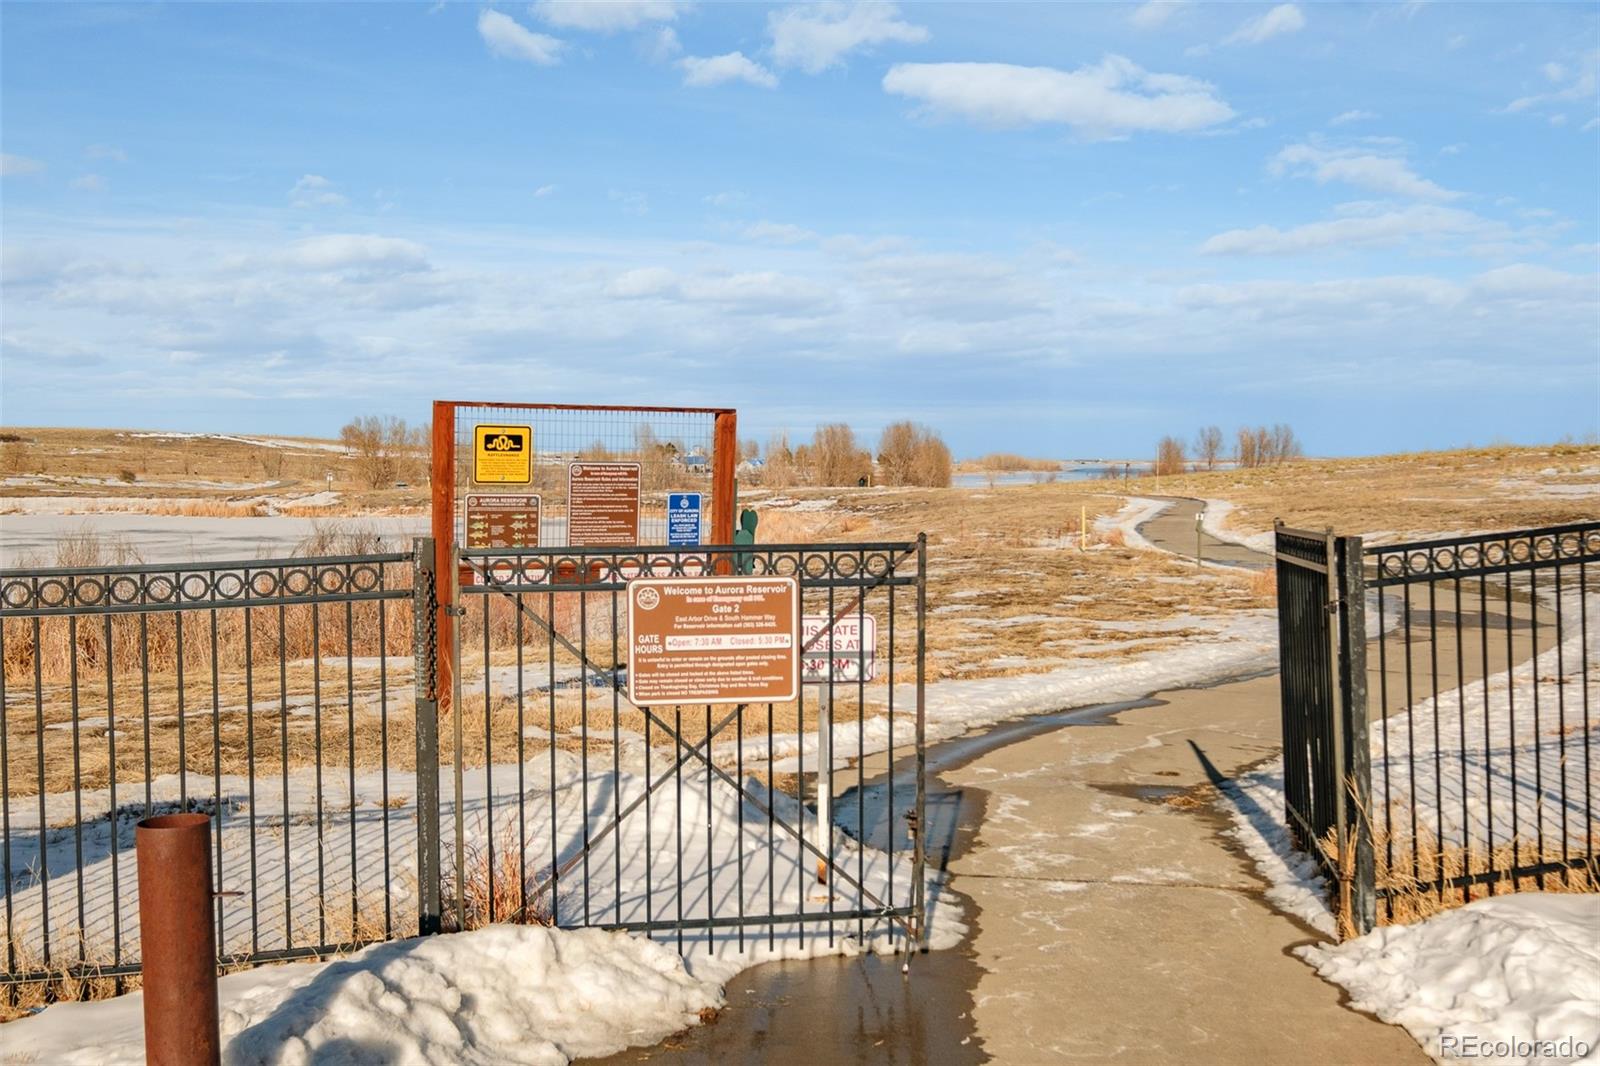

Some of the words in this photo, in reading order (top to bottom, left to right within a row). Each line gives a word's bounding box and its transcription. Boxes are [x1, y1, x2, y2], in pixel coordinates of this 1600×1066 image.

[664, 586, 702, 595] Welcome
[704, 586, 713, 594] to
[715, 586, 745, 594] Aurora
[747, 585, 787, 594] Reservoir
[712, 604, 732, 613] Gate
[734, 604, 740, 613] 2
[638, 635, 660, 644] GATE
[672, 638, 692, 648] Open:
[711, 637, 722, 645] AM
[730, 637, 755, 646] Closed:
[758, 636, 772, 645] 5:30
[774, 636, 785, 644] PM
[635, 645, 663, 654] HOURS
